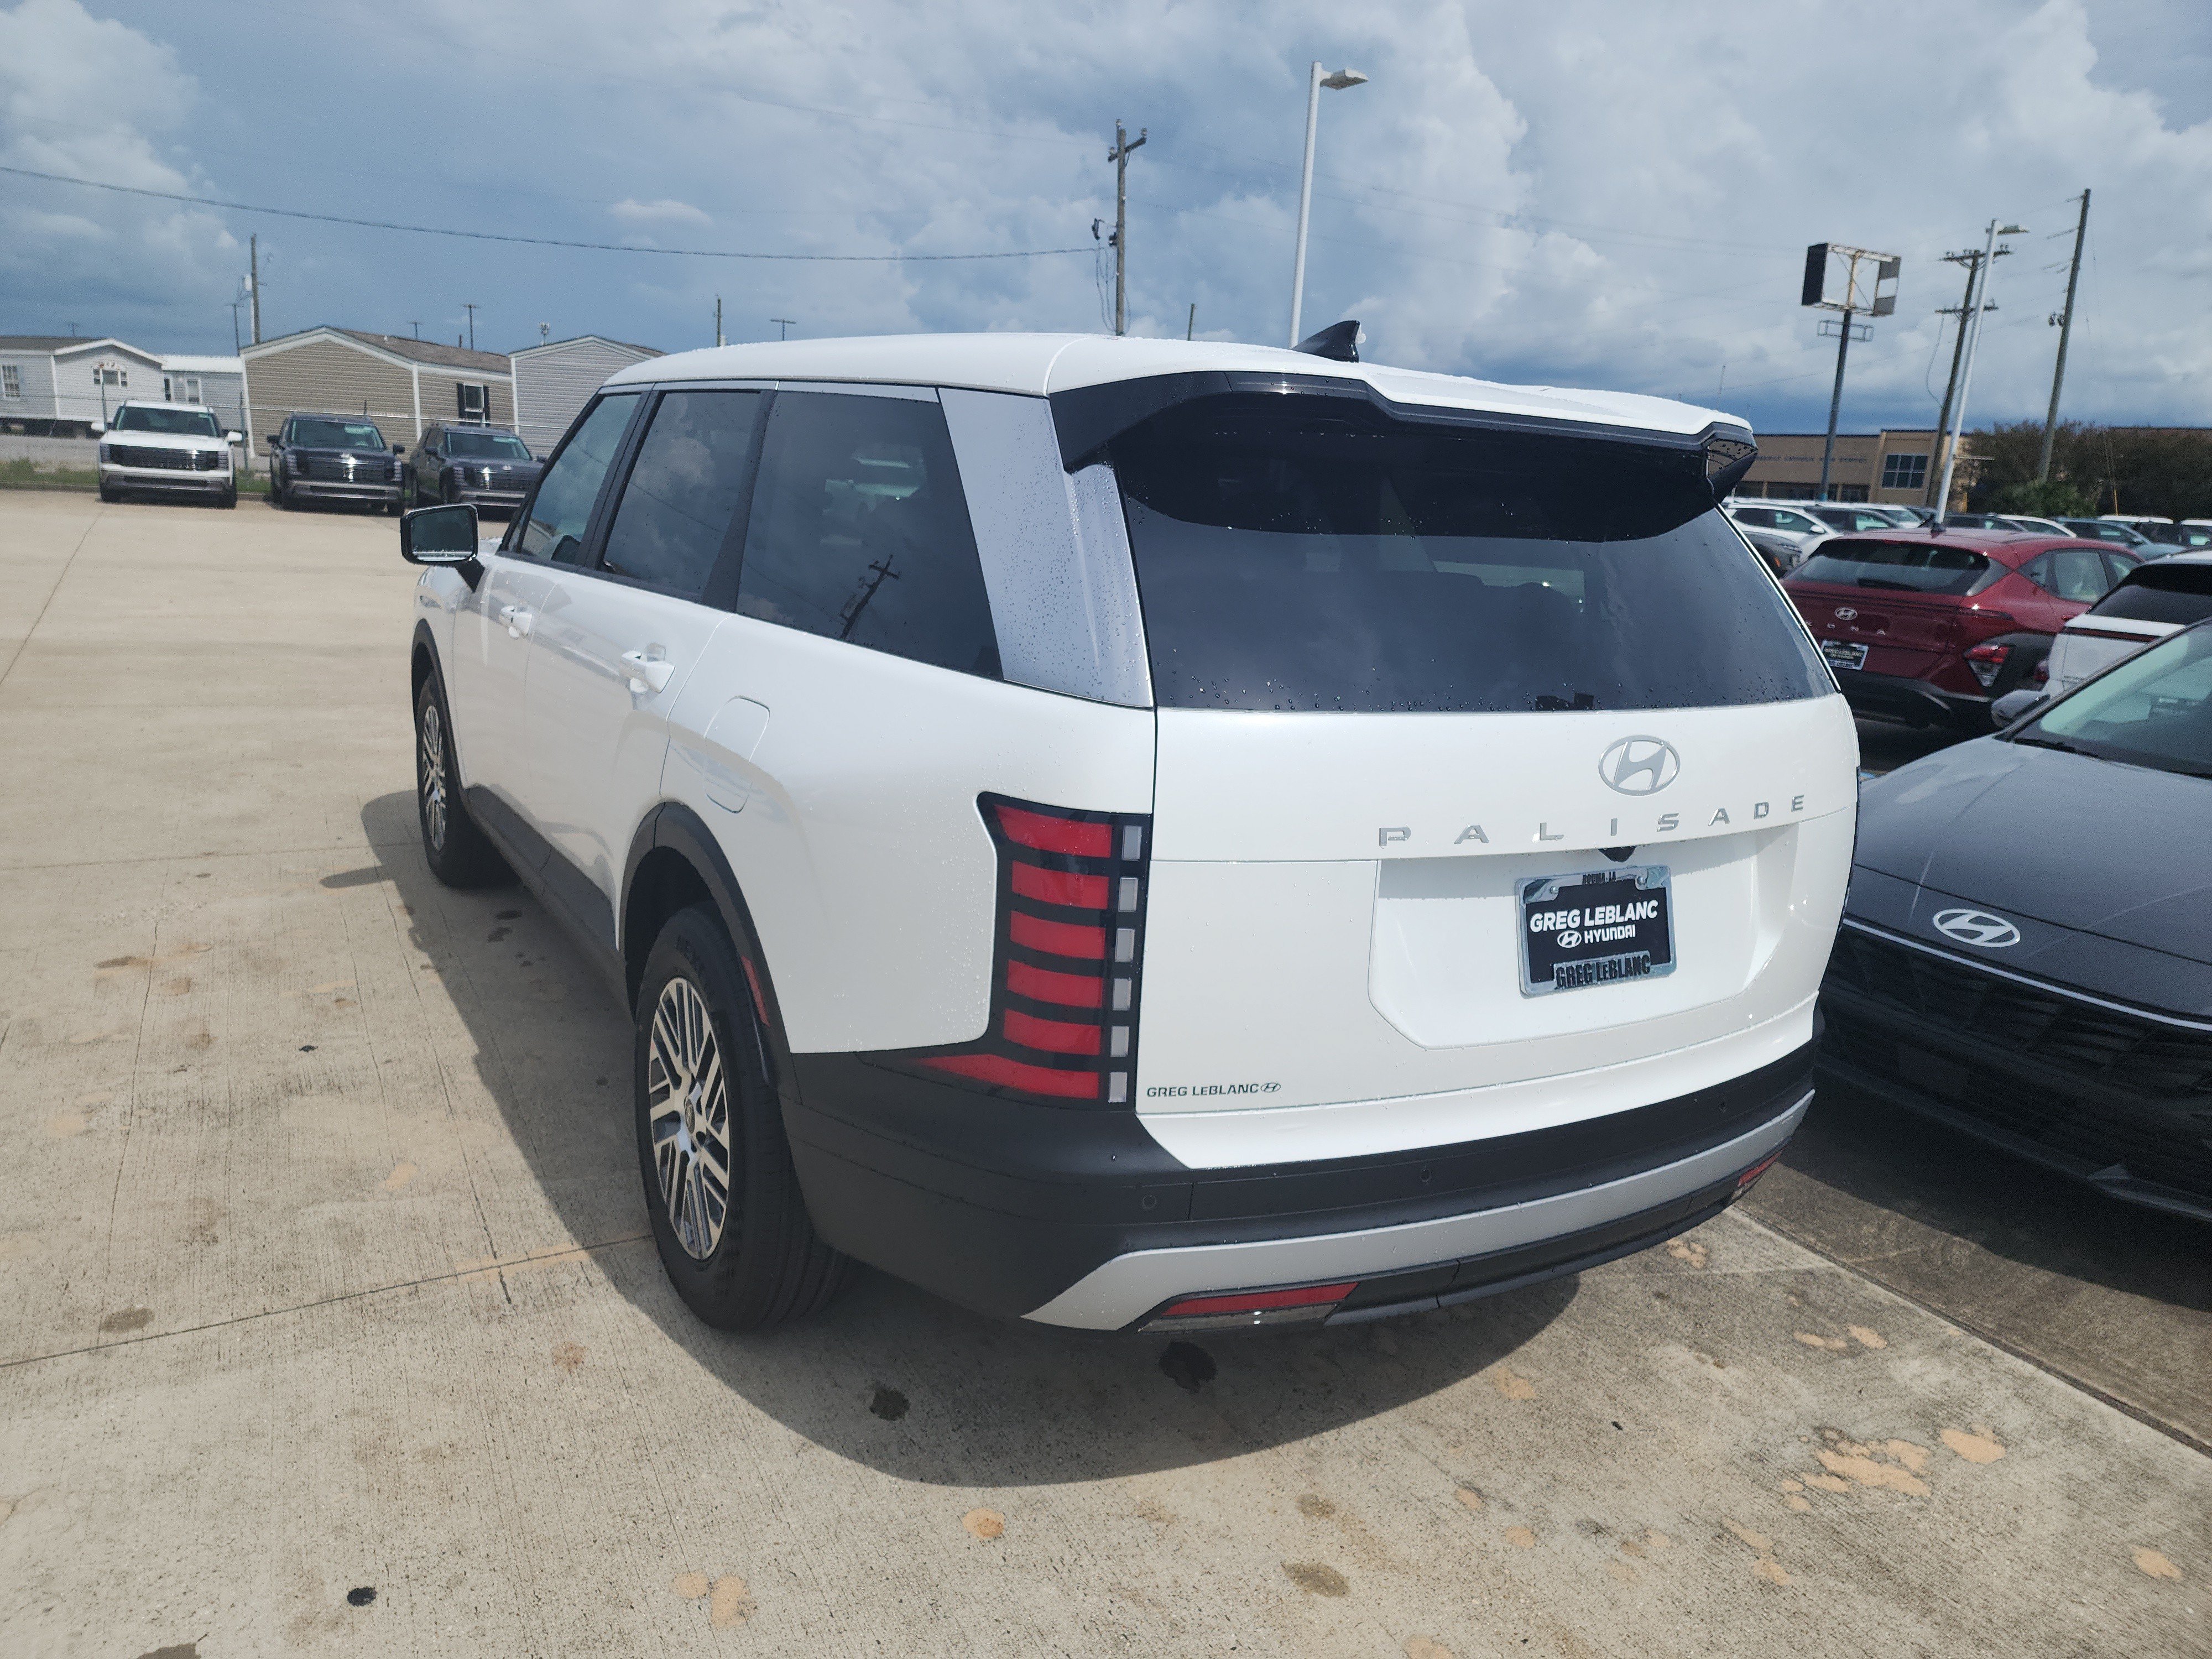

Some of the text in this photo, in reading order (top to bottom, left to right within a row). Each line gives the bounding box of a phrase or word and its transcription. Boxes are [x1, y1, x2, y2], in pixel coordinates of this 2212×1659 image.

[1379, 794, 1805, 848] PALISADE
[1530, 900, 1658, 933] GREG LEBLANC
[1584, 924, 1636, 944] HYUNDAI
[1556, 954, 1651, 989] GREG LEBLANC
[1146, 1083, 1260, 1097] GREG LEBLANC
